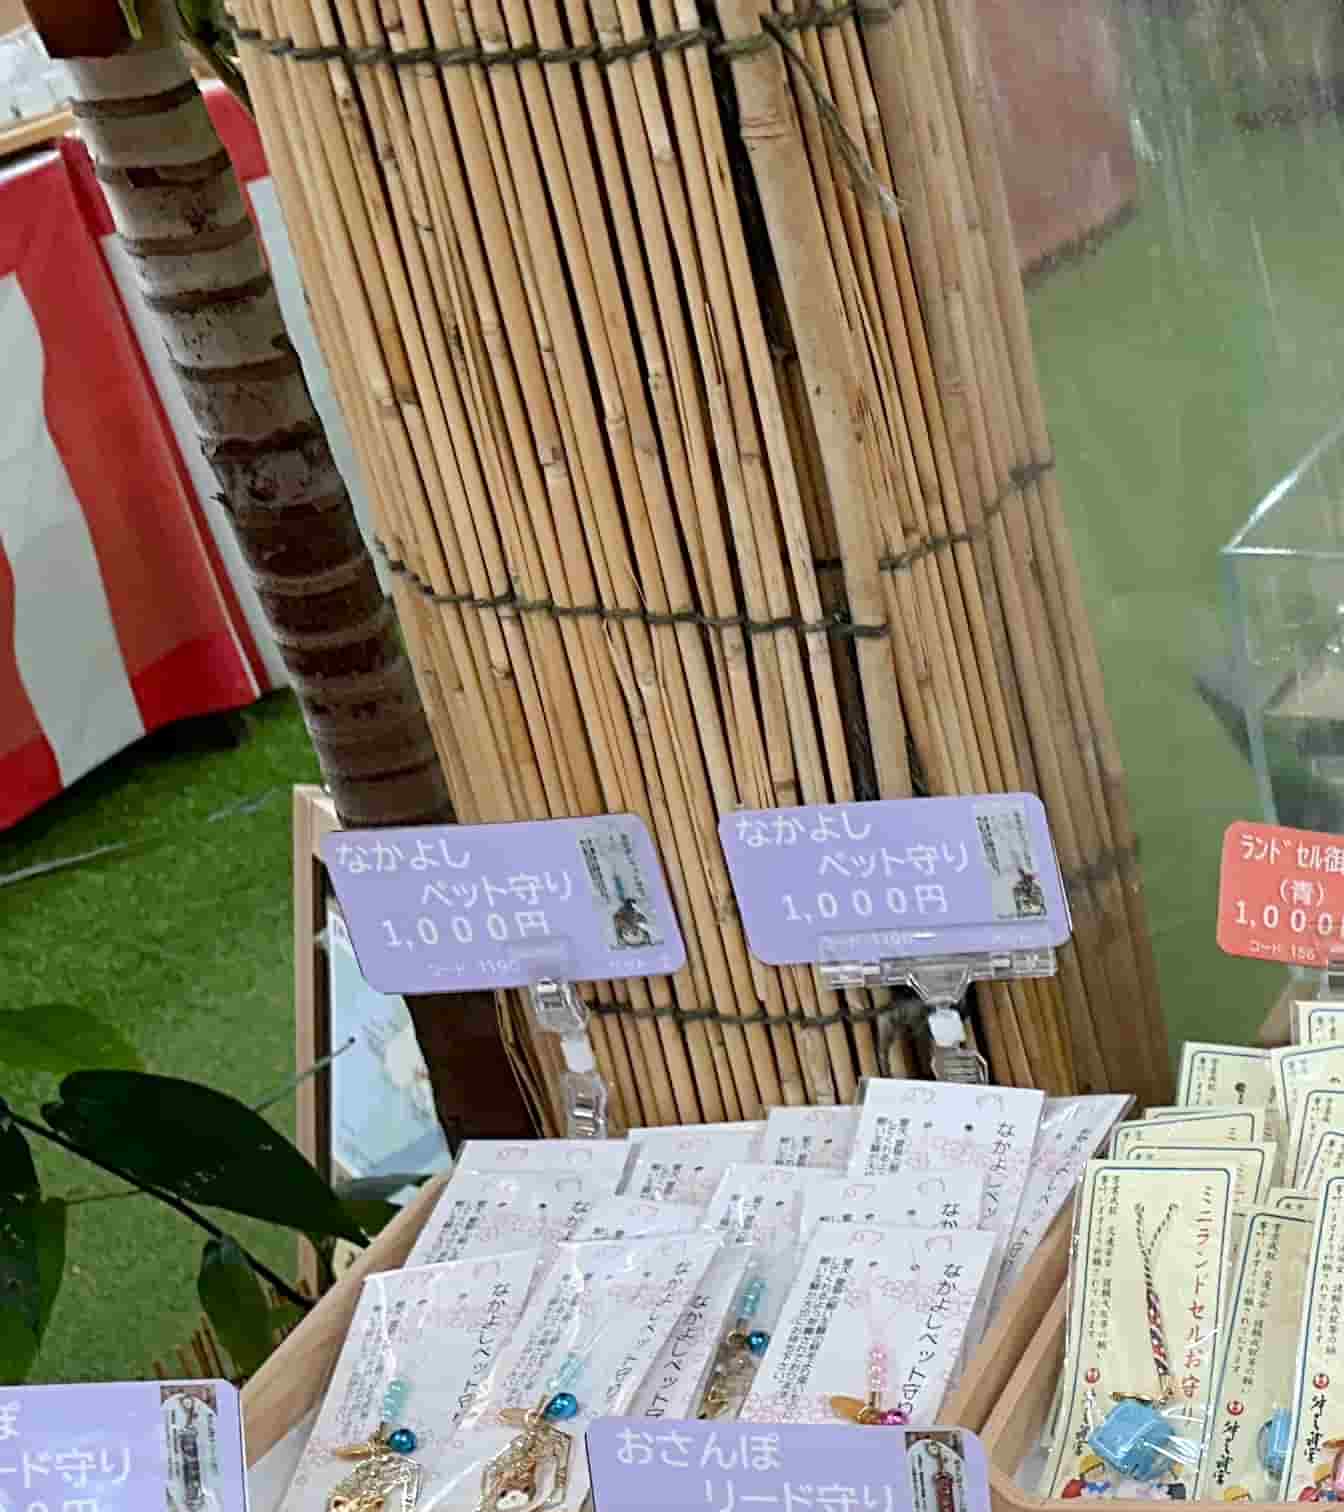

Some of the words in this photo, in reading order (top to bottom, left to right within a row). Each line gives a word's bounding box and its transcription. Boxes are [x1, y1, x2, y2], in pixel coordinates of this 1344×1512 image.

[736, 811, 872, 848] なかよし
[336, 839, 470, 873] なかよし
[783, 884, 948, 925] 1,000円
[381, 911, 549, 951] 1,000円
[616, 1428, 781, 1471] おさんぽ
